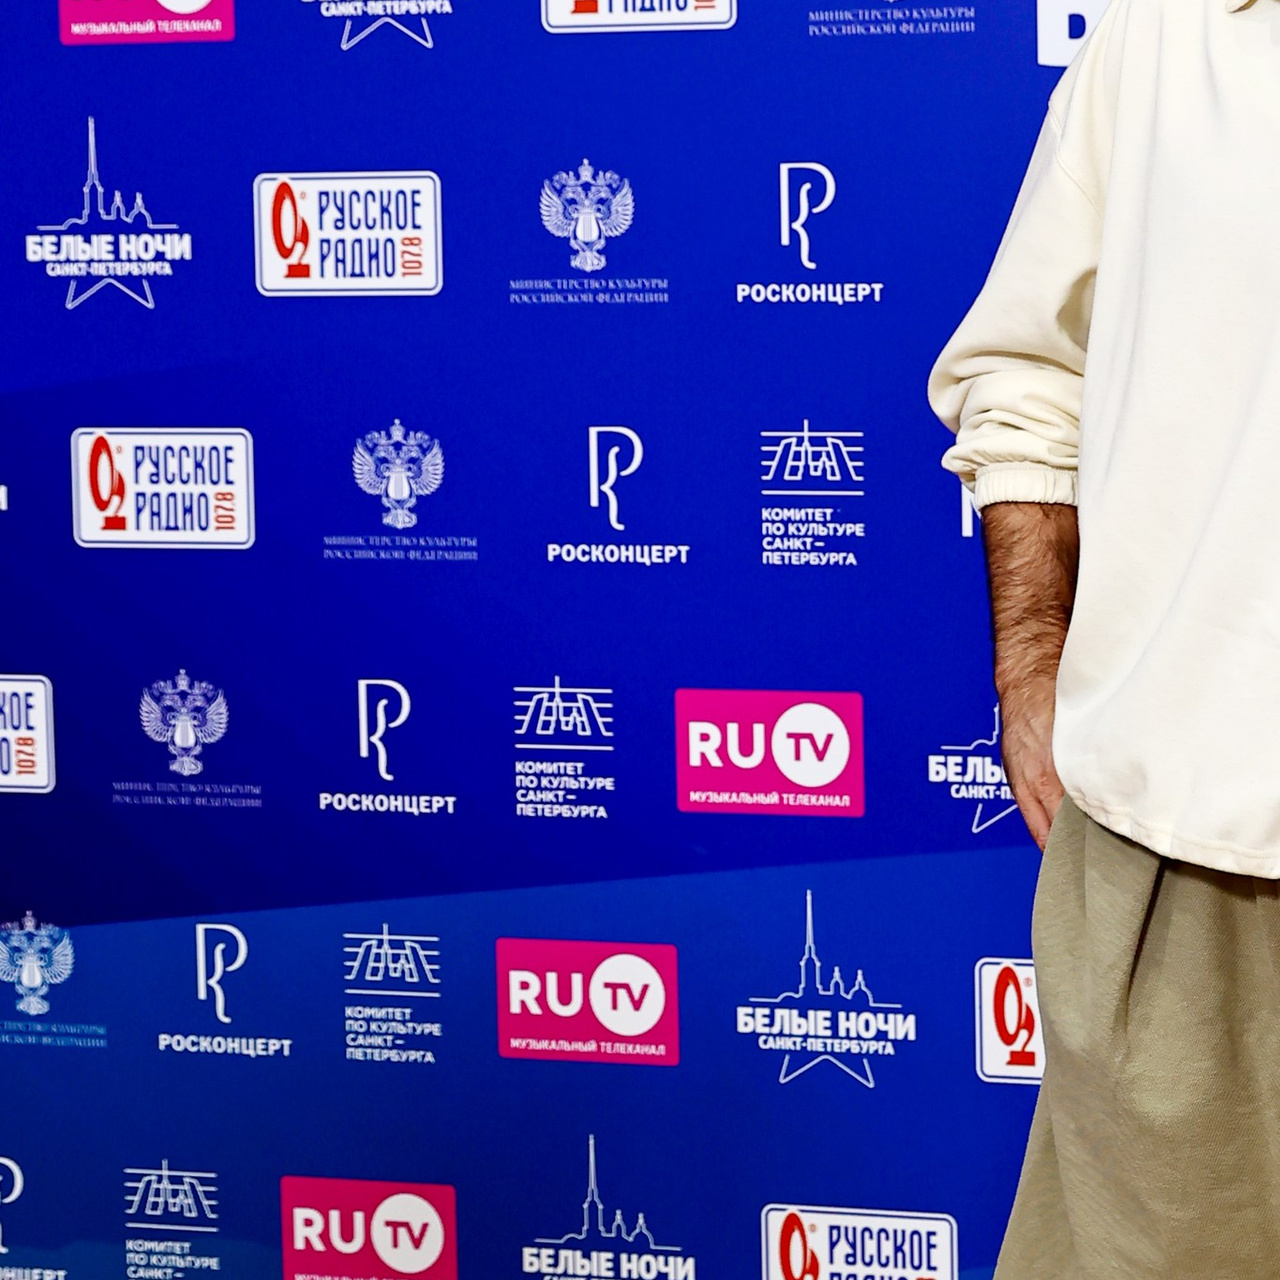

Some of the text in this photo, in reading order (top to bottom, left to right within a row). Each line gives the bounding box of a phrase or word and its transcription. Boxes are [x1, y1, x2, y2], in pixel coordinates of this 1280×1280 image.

[317, 190, 422, 231] РУССКОЕ
[26, 234, 192, 261] БЕЛЫЕ НОЧИ
[319, 238, 395, 278] РАДИО
[736, 283, 884, 305] РОСКОНЦЕРТ
[133, 446, 235, 486] РУССКОЕ
[135, 492, 209, 532] РАДИО
[761, 508, 833, 522] КОМИТЕТ
[762, 522, 865, 537] ПО КУЛЬТУРЕ
[547, 543, 691, 566] РОСКОНЦЕРТ
[762, 550, 857, 566] ПЕТЕРБУРГА
[688, 721, 834, 769] RU TV
[515, 760, 584, 775] КОМИТЕТ
[927, 754, 1008, 784] БЕЛЫ
[516, 774, 615, 791] ПО КУЛЬТУРЕ
[319, 792, 457, 817] РОСКОНЦЕРТ
[516, 802, 607, 819] ПЕТЕРБУРГА
[508, 969, 650, 1017] RU TV
[736, 1006, 916, 1040] БЕЛЫЕ НОЧИ
[159, 1033, 293, 1060] РОСКОНЦЕРТ
[293, 1206, 430, 1254] RU TV
[522, 1246, 615, 1277] БЕЛЫЕ
[827, 1225, 938, 1271] РУССКОЕ
